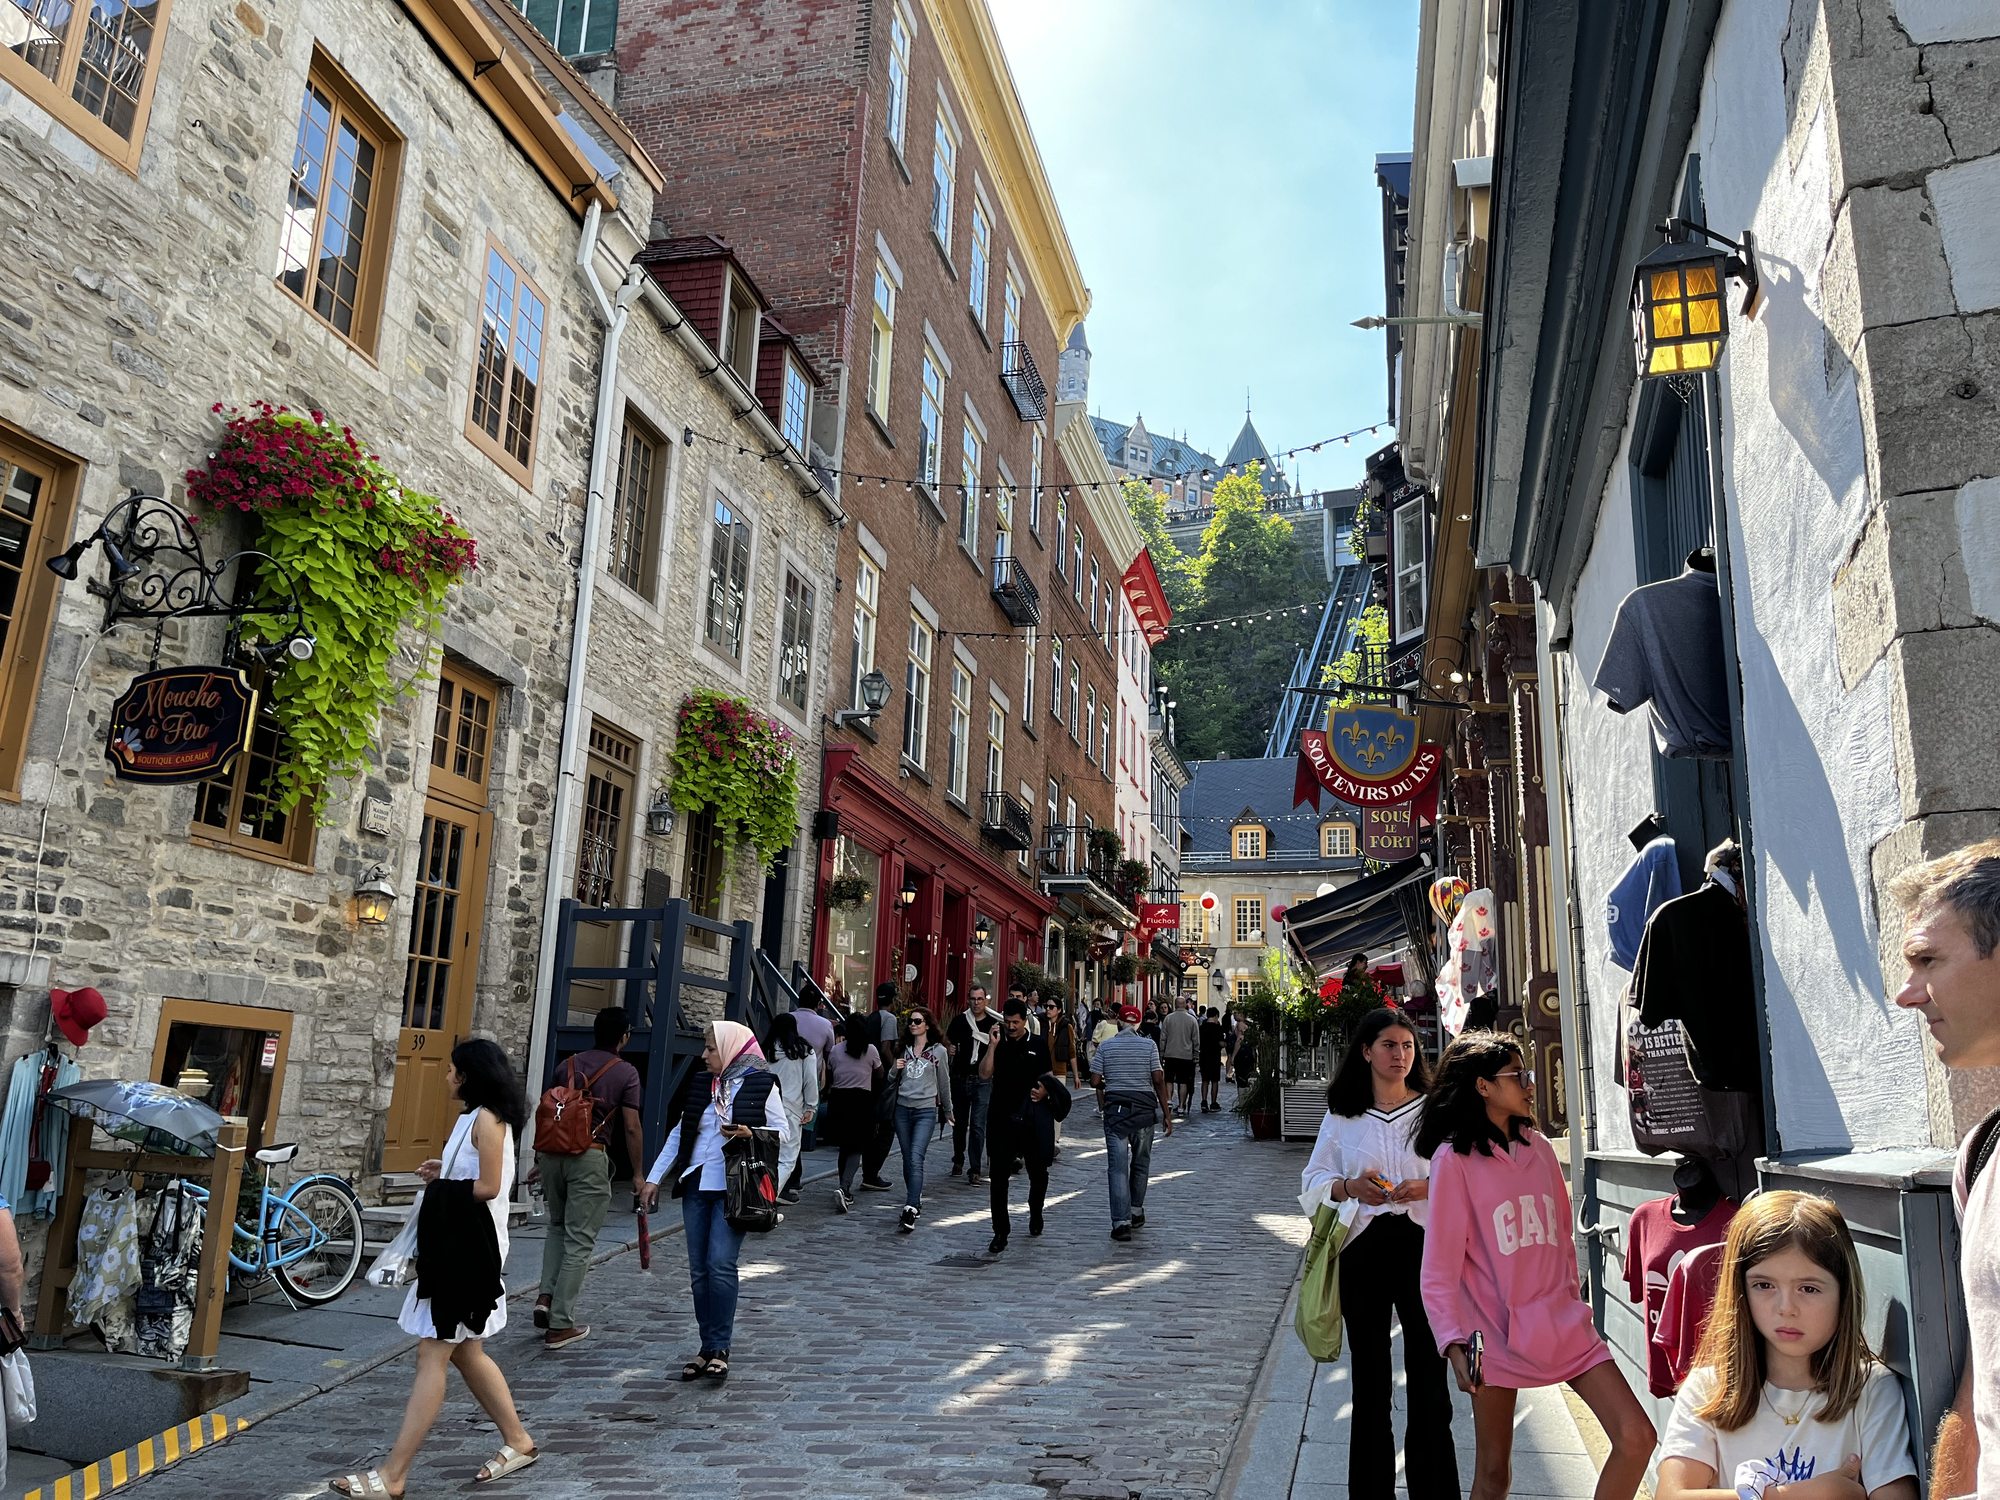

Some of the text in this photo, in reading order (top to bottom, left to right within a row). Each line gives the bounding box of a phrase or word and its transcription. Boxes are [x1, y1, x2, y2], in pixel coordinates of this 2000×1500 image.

[125, 672, 222, 722] Mouche
[145, 711, 210, 745] à Feu
[137, 751, 210, 766] BOUTIQUE CADEAUX
[1307, 738, 1436, 801] SOUVENIRS DU LYS
[1371, 810, 1410, 823] SOUS
[1385, 824, 1397, 833] LE
[1369, 835, 1414, 848] FORT
[1146, 917, 1176, 925] Fluchos
[412, 1034, 426, 1051] 39
[1644, 1036, 1653, 1049] IS
[1646, 1049, 1666, 1058] THAN
[1670, 1125, 1695, 1134] CANADA
